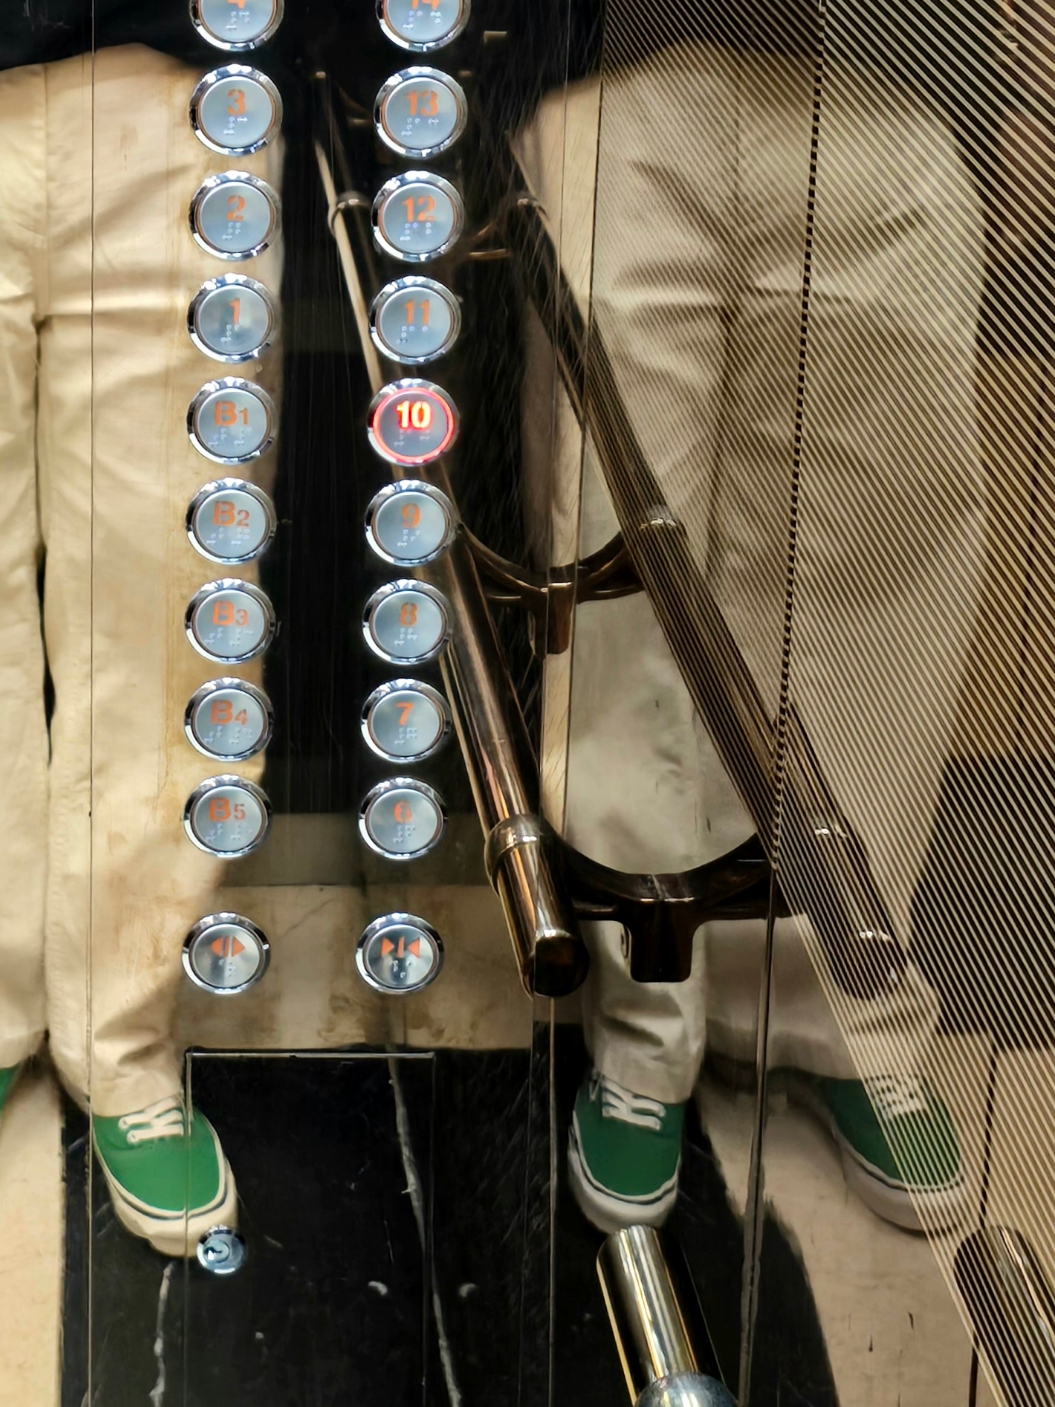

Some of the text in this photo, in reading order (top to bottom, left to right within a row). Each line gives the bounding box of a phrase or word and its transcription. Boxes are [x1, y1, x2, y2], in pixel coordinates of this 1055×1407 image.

[227, 89, 246, 115] 3
[406, 89, 438, 116] 13
[227, 195, 246, 221] 2
[402, 195, 436, 222] 12
[229, 298, 241, 324] 1
[404, 299, 430, 325] 11
[214, 400, 248, 426] B1
[396, 400, 432, 429] 10
[213, 500, 250, 527] B2
[402, 503, 421, 528] 9
[213, 601, 248, 626] B3
[399, 602, 418, 627] 8
[211, 700, 247, 725] B4
[396, 702, 415, 726] 7
[209, 797, 246, 822] B5
[394, 800, 412, 825] 6
